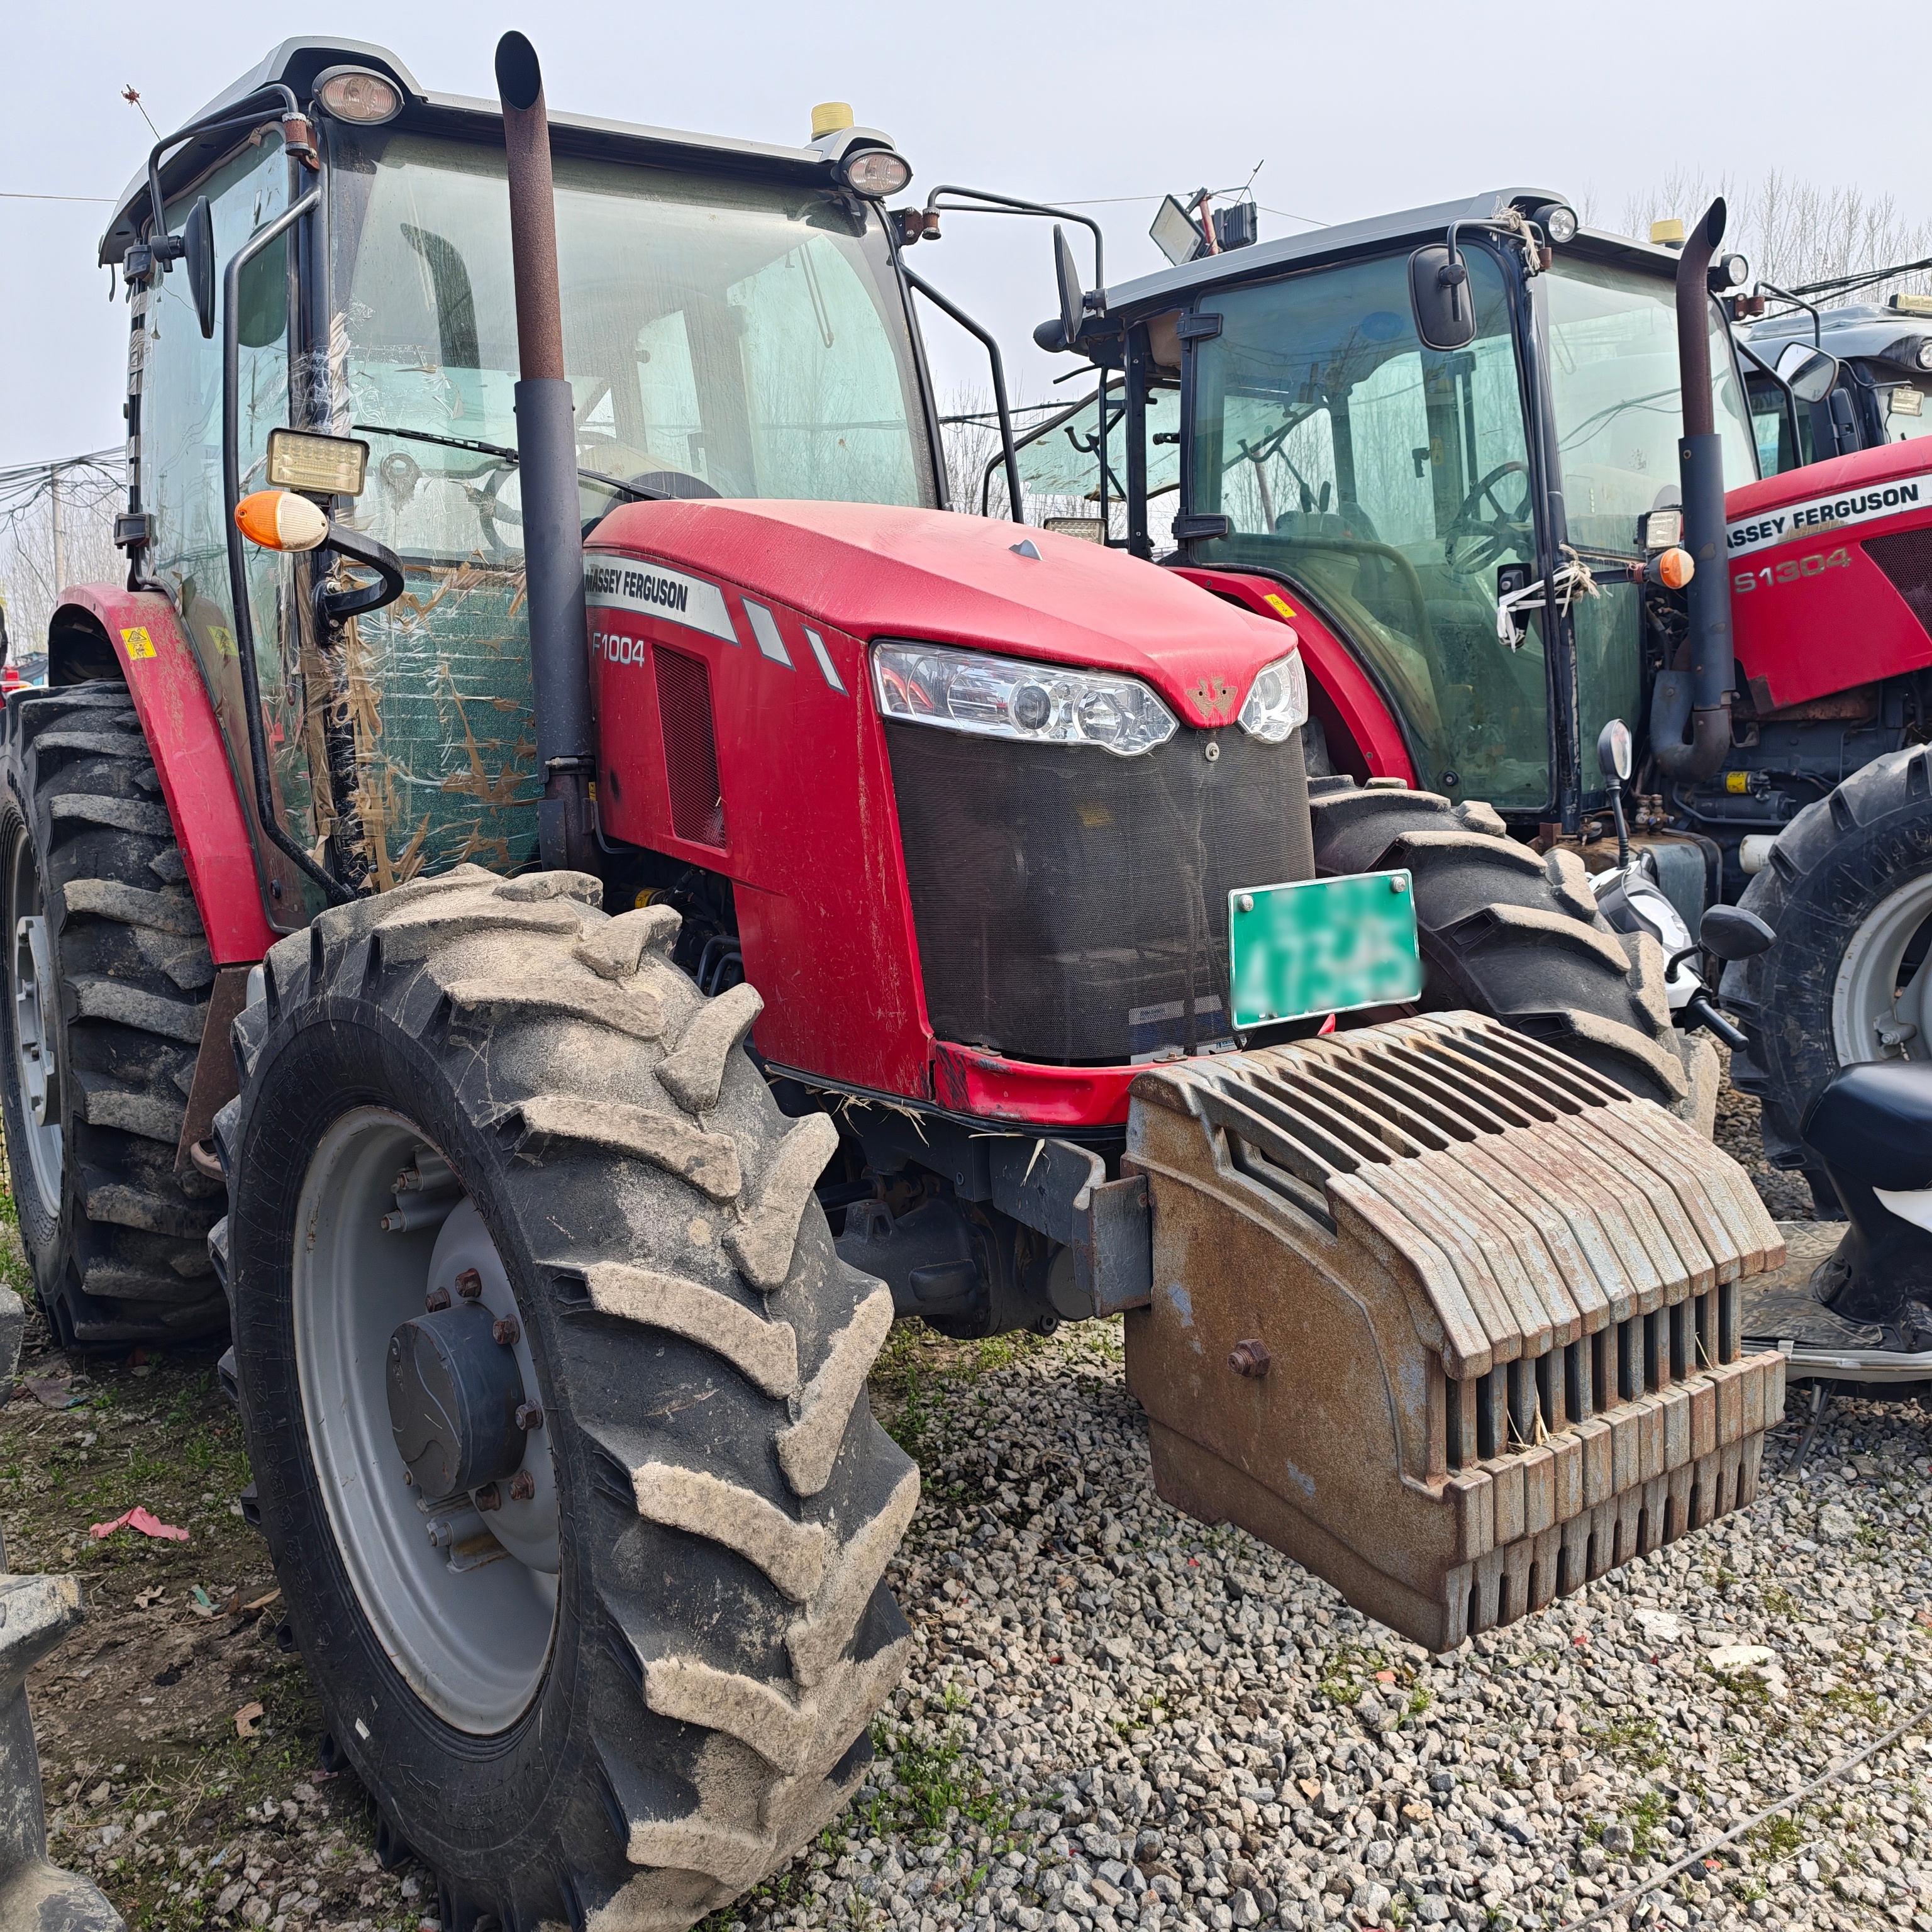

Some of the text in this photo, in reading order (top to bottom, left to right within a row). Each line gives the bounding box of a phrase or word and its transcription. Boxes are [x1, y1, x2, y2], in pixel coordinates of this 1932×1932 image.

[1792, 484, 1919, 529] FERGUSON
[623, 571, 689, 613] FERGUSON
[1734, 547, 1852, 594] S1304
[592, 631, 645, 668] F1004
